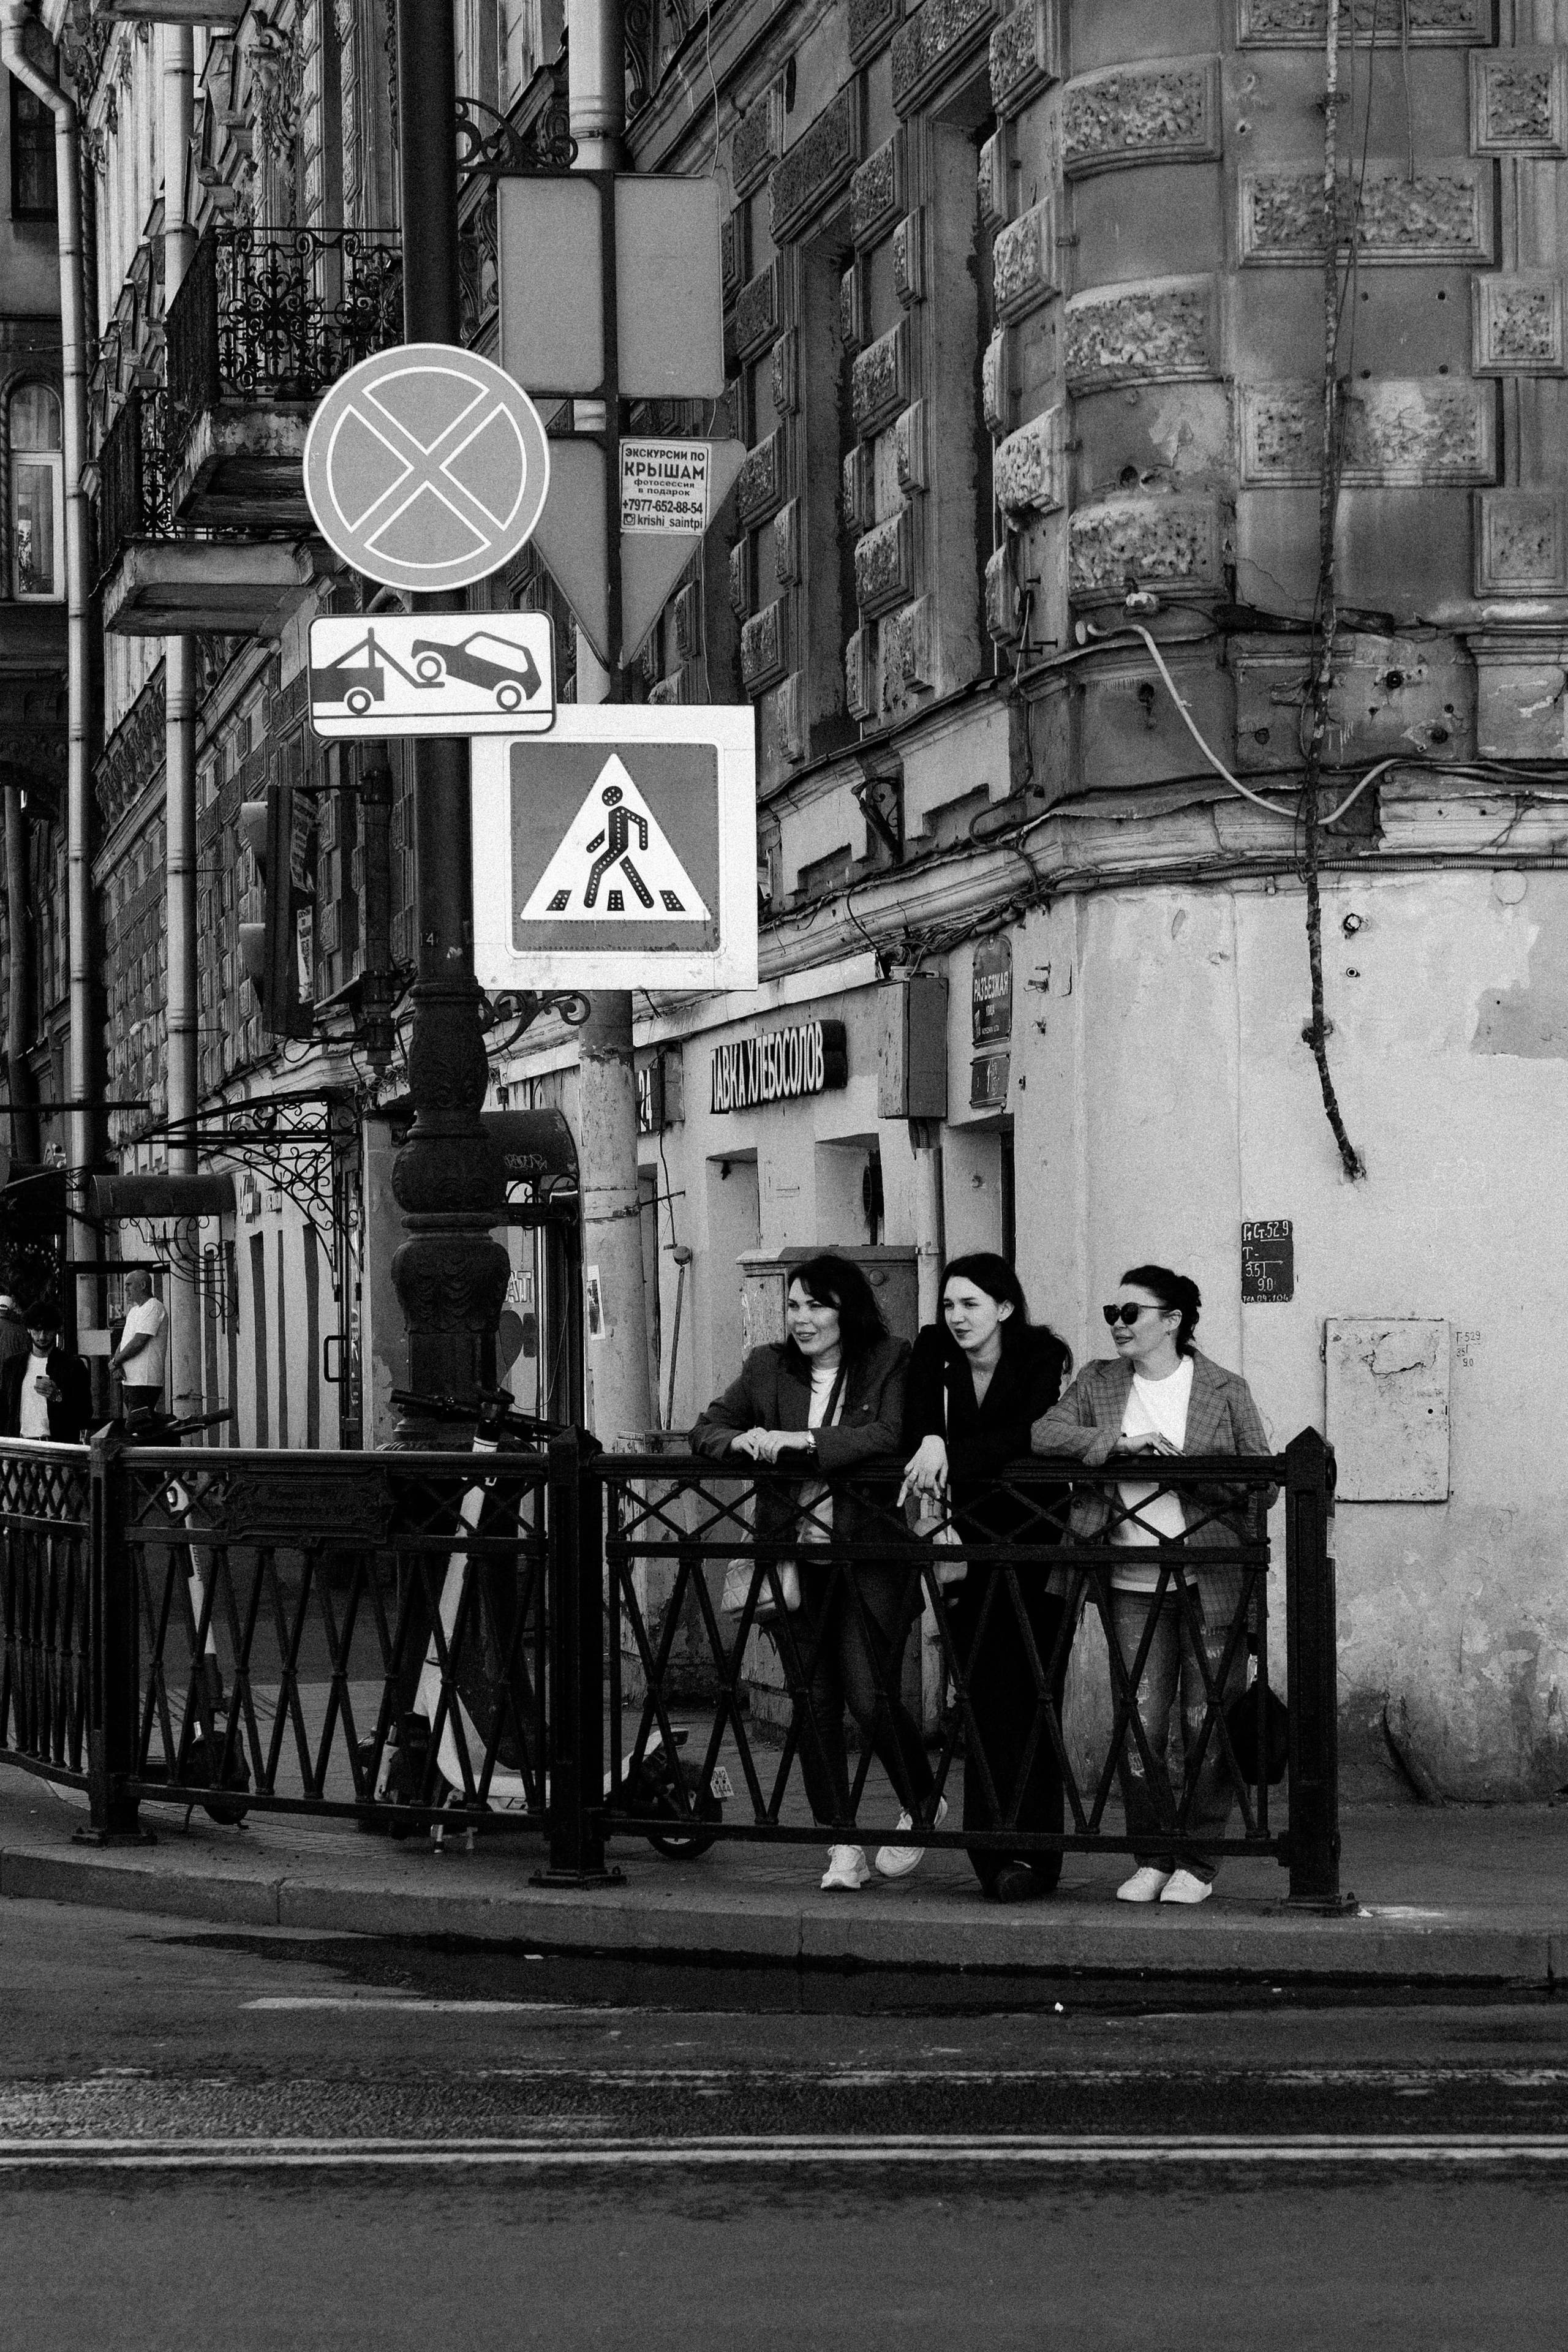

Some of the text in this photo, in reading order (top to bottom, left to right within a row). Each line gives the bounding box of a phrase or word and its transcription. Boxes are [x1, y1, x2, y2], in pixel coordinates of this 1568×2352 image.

[625, 448, 705, 461] ЭКСКУРСИИ ПО
[624, 461, 704, 480] КРЫШАМ
[634, 478, 695, 488] фотосессия
[647, 488, 690, 497] подарок
[622, 499, 703, 514] +7977-652-88-54
[638, 514, 703, 531] krishi_saintpi
[973, 971, 1008, 1002] РАЗЪЕЗЖАЯ
[710, 1020, 824, 1112] ЛАВКА ХЛЕБОСОЛОВ
[638, 1069, 652, 1133] 24
